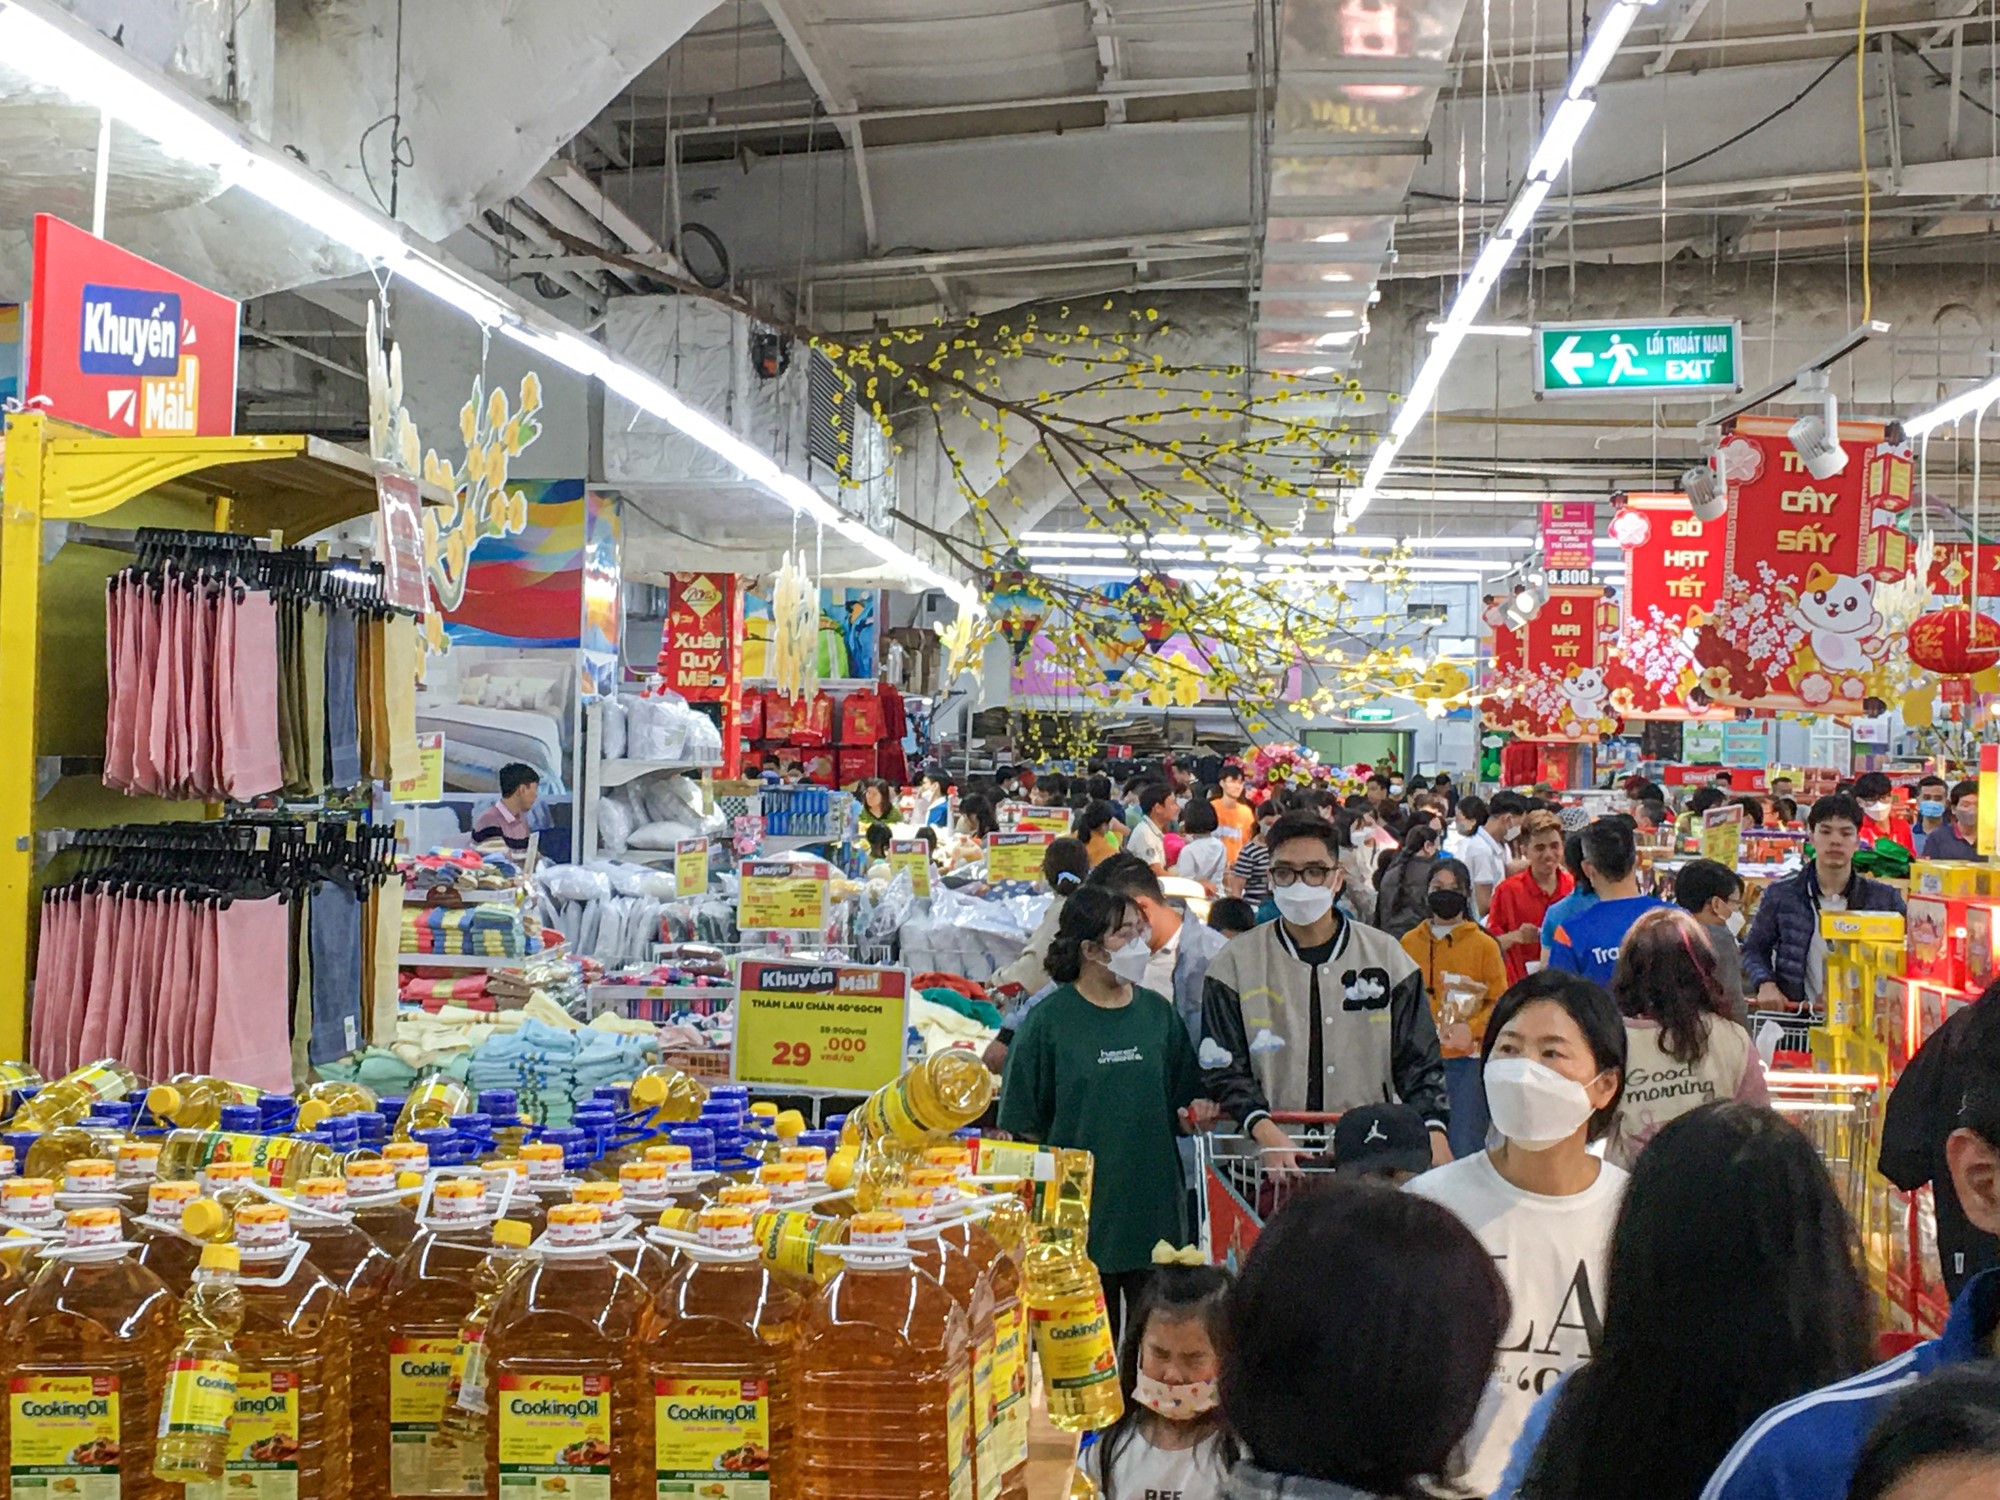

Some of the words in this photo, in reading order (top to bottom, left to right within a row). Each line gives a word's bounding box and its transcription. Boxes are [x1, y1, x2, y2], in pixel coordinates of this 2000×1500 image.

[84, 302, 176, 366] Khuyến
[1646, 331, 1664, 355] LỐI
[1666, 331, 1700, 354] THOÁT
[1703, 334, 1728, 357] NẠN
[1666, 359, 1714, 380] EXIT
[1781, 486, 1838, 514] CÂY
[1777, 522, 1837, 554] SẤY
[1664, 550, 1709, 571] HẠT
[1665, 574, 1706, 598] TẾT
[673, 631, 729, 649] Xuân
[1551, 624, 1581, 637] MAI
[1551, 640, 1581, 657] TẾT
[680, 651, 722, 672] Quý
[678, 670, 720, 687] Mã
[789, 907, 805, 918] 24
[762, 966, 834, 989] Khuyến
[783, 1001, 803, 1010] LAU
[772, 1041, 812, 1067] 29
[1626, 1064, 1694, 1087] Good
[1626, 1079, 1715, 1104] morning
